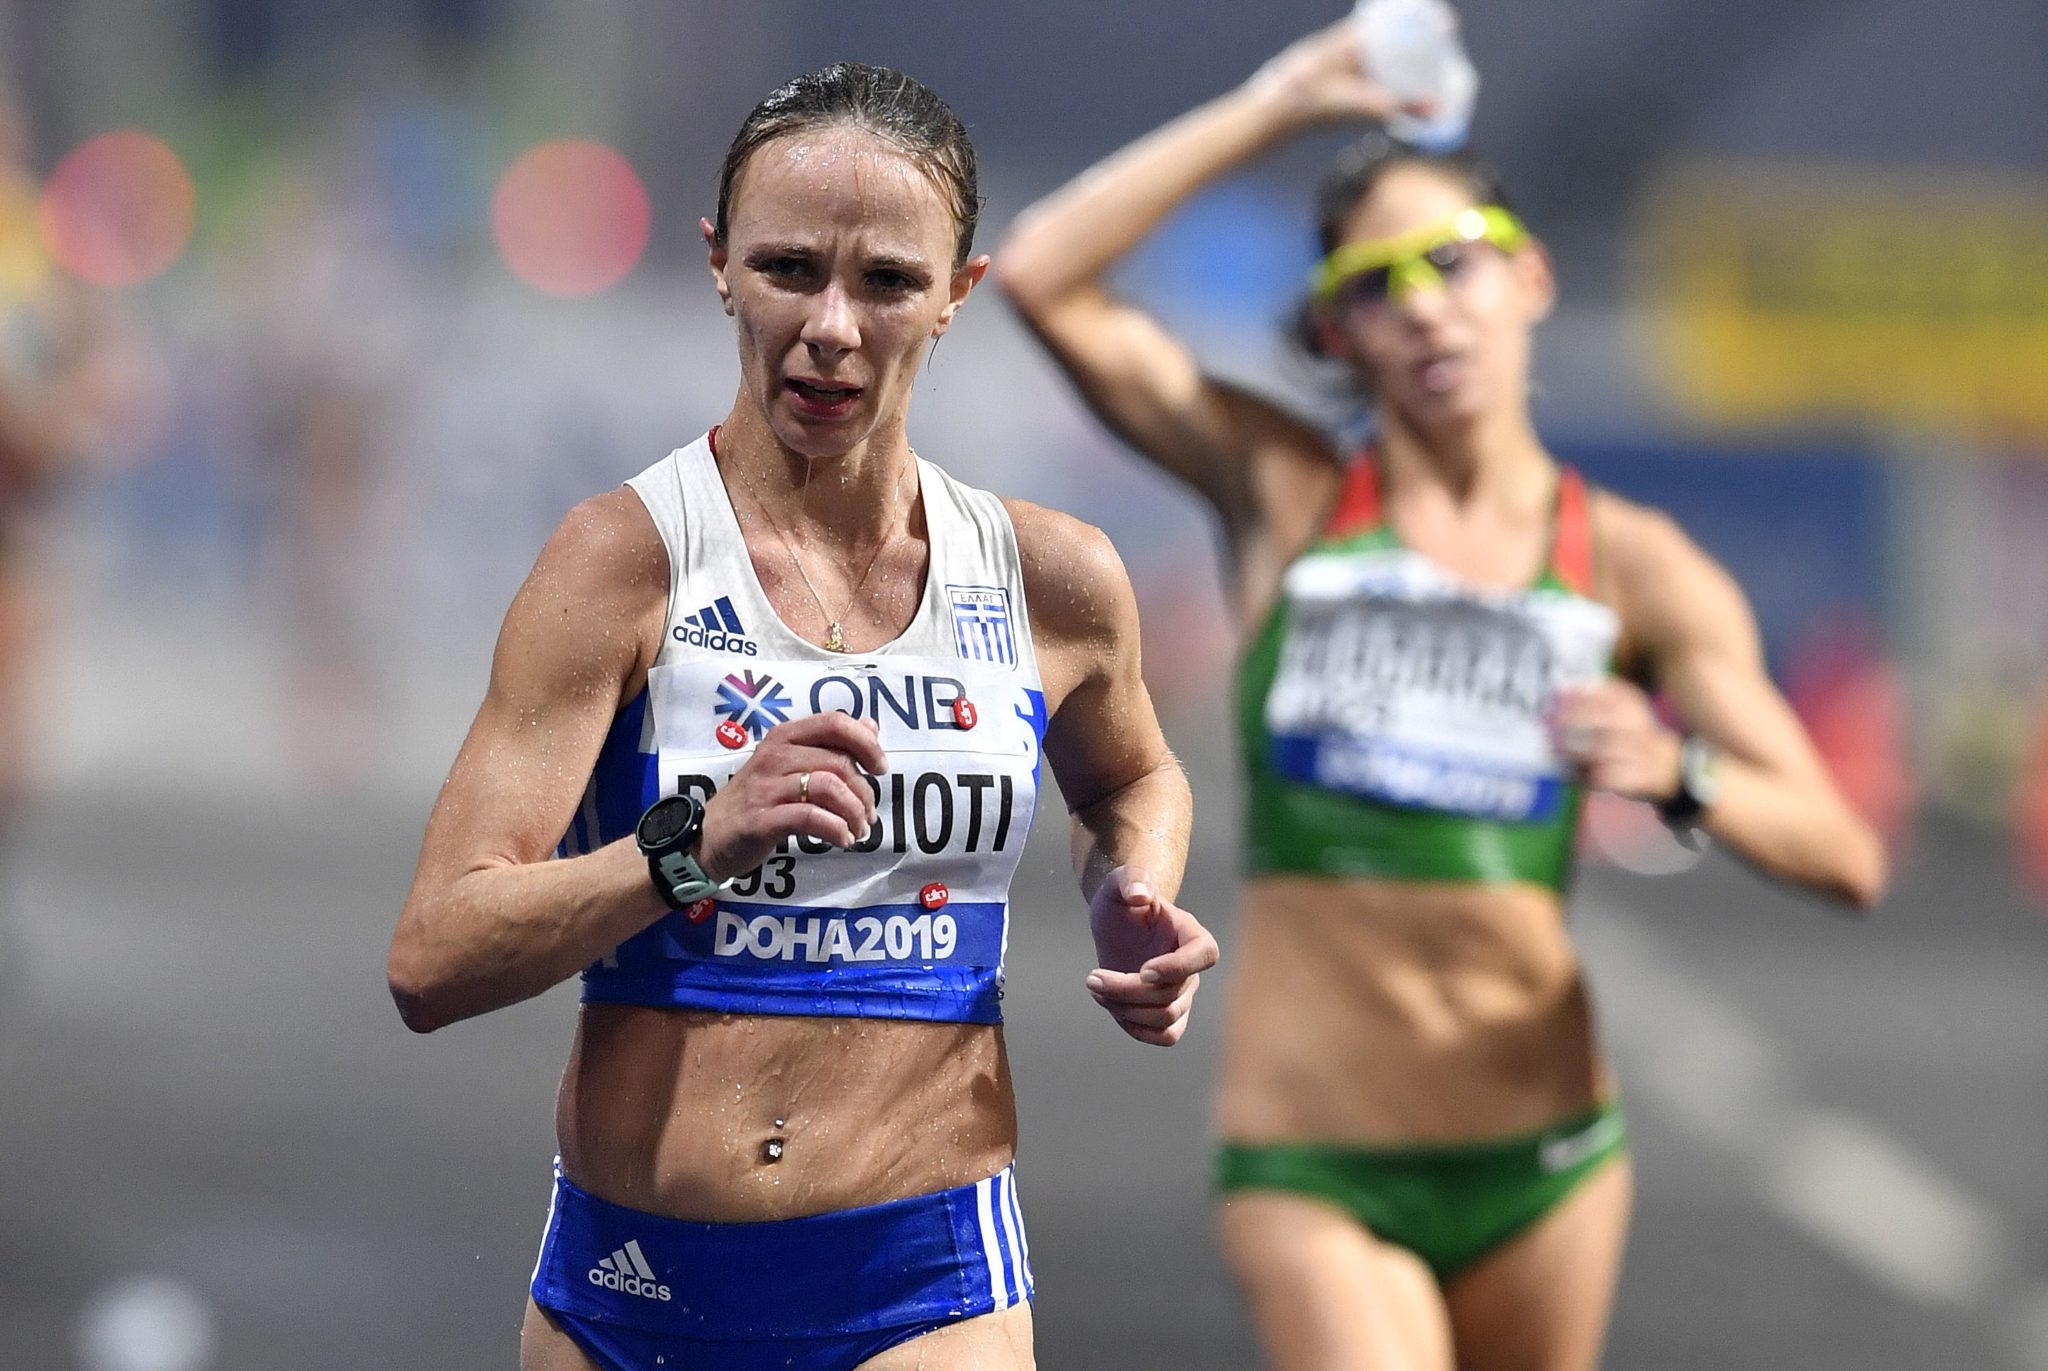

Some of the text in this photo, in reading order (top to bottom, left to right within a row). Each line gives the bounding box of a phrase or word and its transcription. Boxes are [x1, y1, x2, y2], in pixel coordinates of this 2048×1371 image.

[672, 625, 758, 657] adidas
[714, 911, 957, 962] DOHA2019
[588, 1268, 672, 1302] adidas
